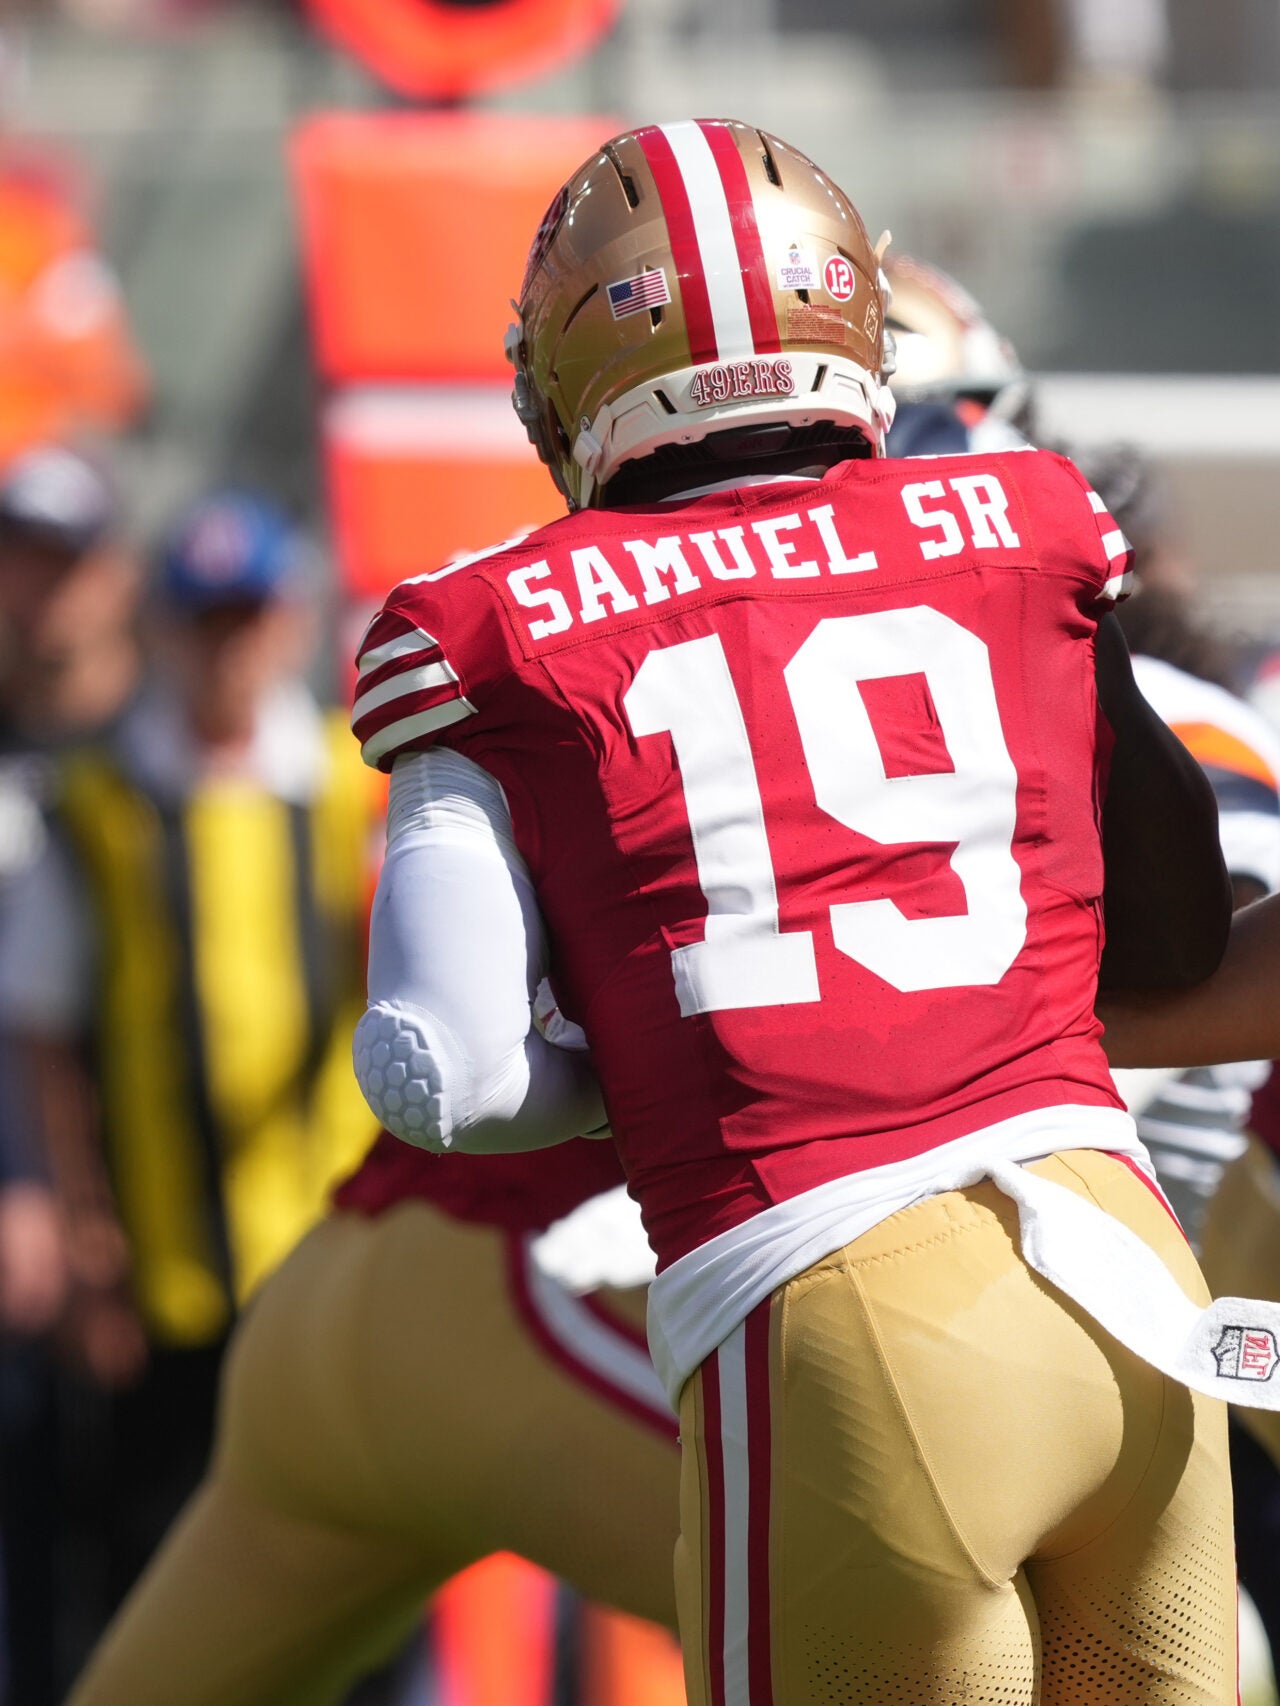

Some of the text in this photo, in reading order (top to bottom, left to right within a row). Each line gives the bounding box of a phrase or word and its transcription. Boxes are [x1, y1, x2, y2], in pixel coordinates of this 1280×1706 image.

[780, 267, 813, 276] CRUCIAL
[786, 275, 811, 283] CATCH
[828, 263, 851, 294] 12
[691, 359, 796, 406] 49ERS
[505, 504, 877, 641] SAMUEL
[900, 473, 1021, 562] SR
[623, 604, 1028, 1018] 19
[1241, 1334, 1273, 1377] NFL
